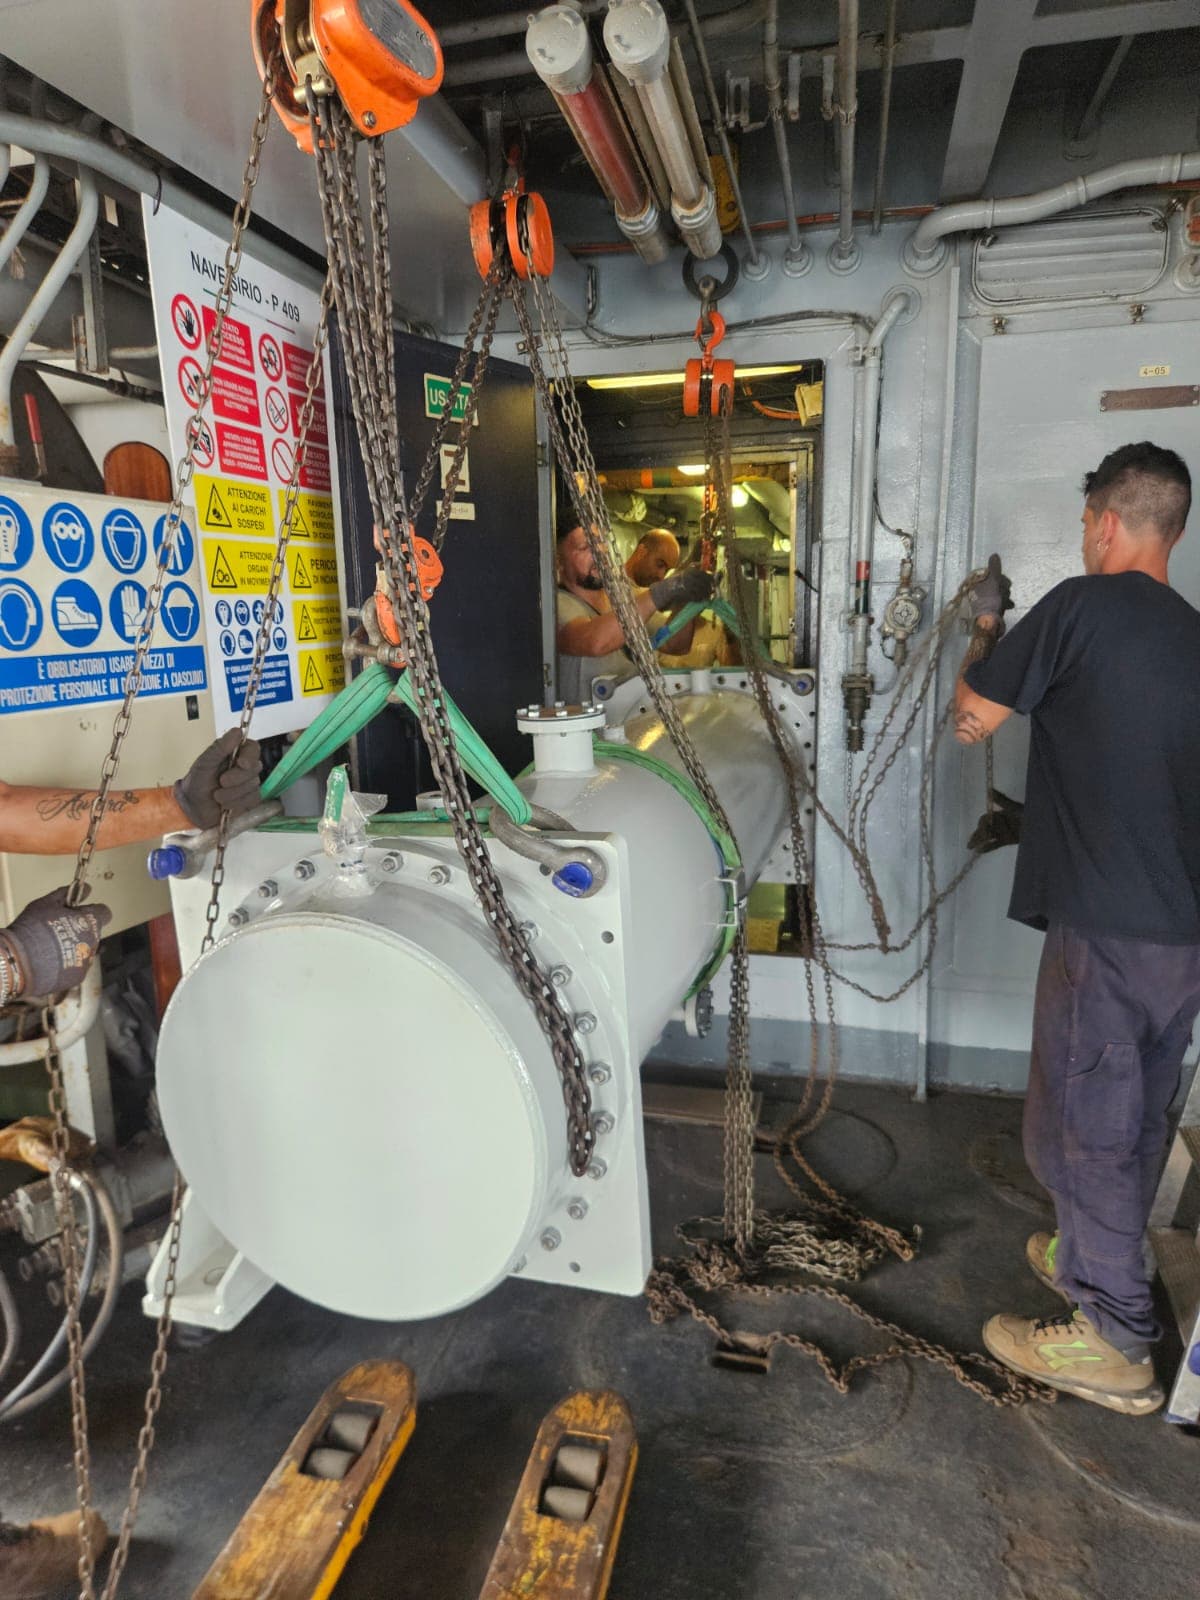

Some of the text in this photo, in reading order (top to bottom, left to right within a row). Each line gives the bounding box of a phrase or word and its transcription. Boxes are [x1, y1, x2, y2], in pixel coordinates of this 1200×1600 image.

[191, 250, 225, 285] NAVE
[230, 275, 262, 304] SIRIO
[271, 294, 279, 311] P
[282, 300, 300, 322] 409
[1143, 366, 1166, 376] 4-05
[227, 487, 267, 502] ATTENZIONE
[232, 503, 266, 516] AI CARICHI
[237, 518, 265, 530] SOSPESI
[240, 551, 273, 561] ATTENZIONE
[38, 653, 175, 679] È OBBLIGATORIO USARE MEZZI DI
[0, 683, 58, 707] PROTEZIONE
[59, 679, 108, 700] PERSONALE
[110, 677, 119, 694] IN
[163, 672, 170, 688] A
[171, 669, 204, 688] CIASCUNO
